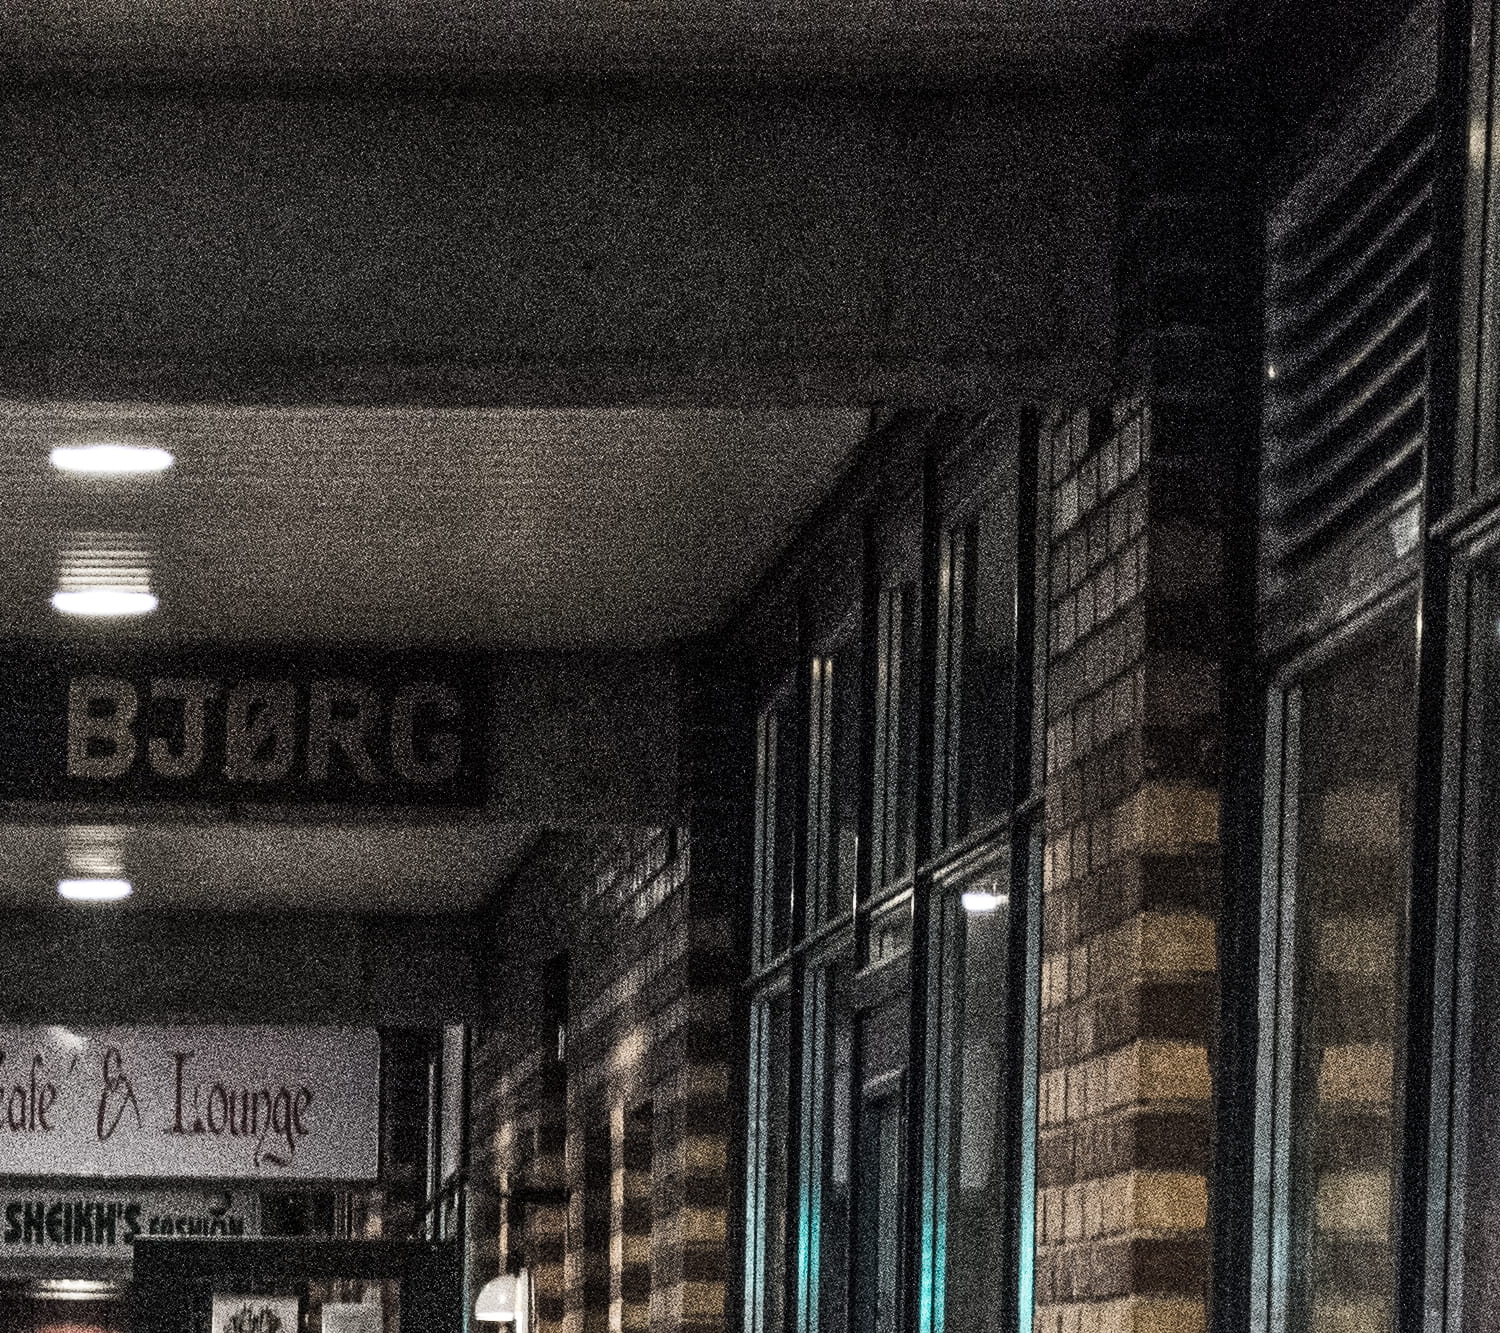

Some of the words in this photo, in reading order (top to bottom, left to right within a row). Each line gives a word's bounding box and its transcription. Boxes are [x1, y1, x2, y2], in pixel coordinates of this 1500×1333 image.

[67, 677, 463, 785] BJØRG
[165, 1051, 313, 1168] Lounge
[3, 1200, 141, 1246] SHEIKH'S
